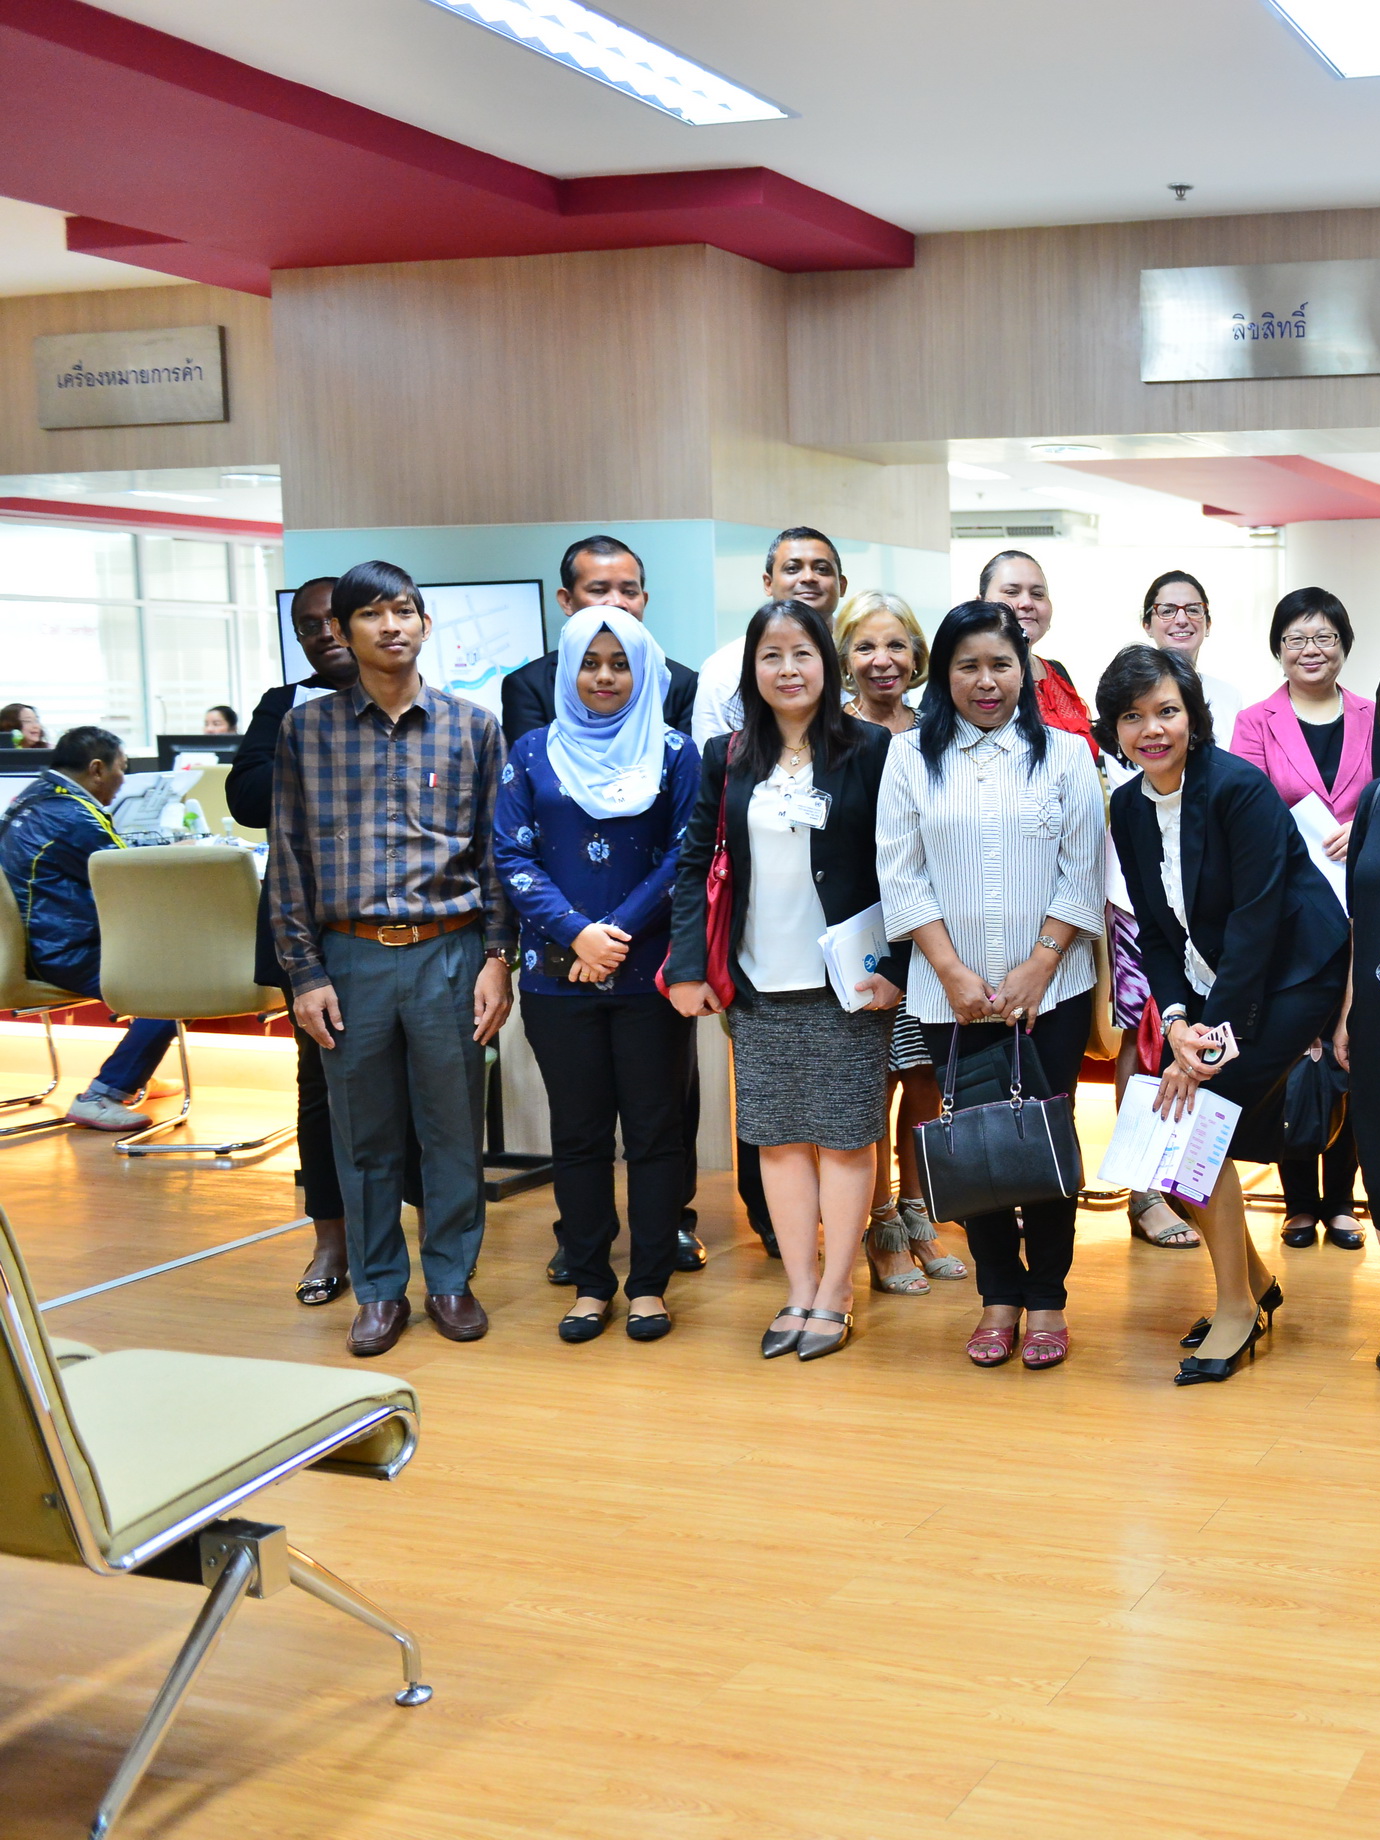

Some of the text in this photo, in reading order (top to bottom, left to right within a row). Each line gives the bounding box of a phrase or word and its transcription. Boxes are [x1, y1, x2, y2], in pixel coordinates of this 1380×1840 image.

[1231, 301, 1309, 342] ลิขสิทธิ์
[56, 357, 204, 389] เครื่องหมายการค้า
